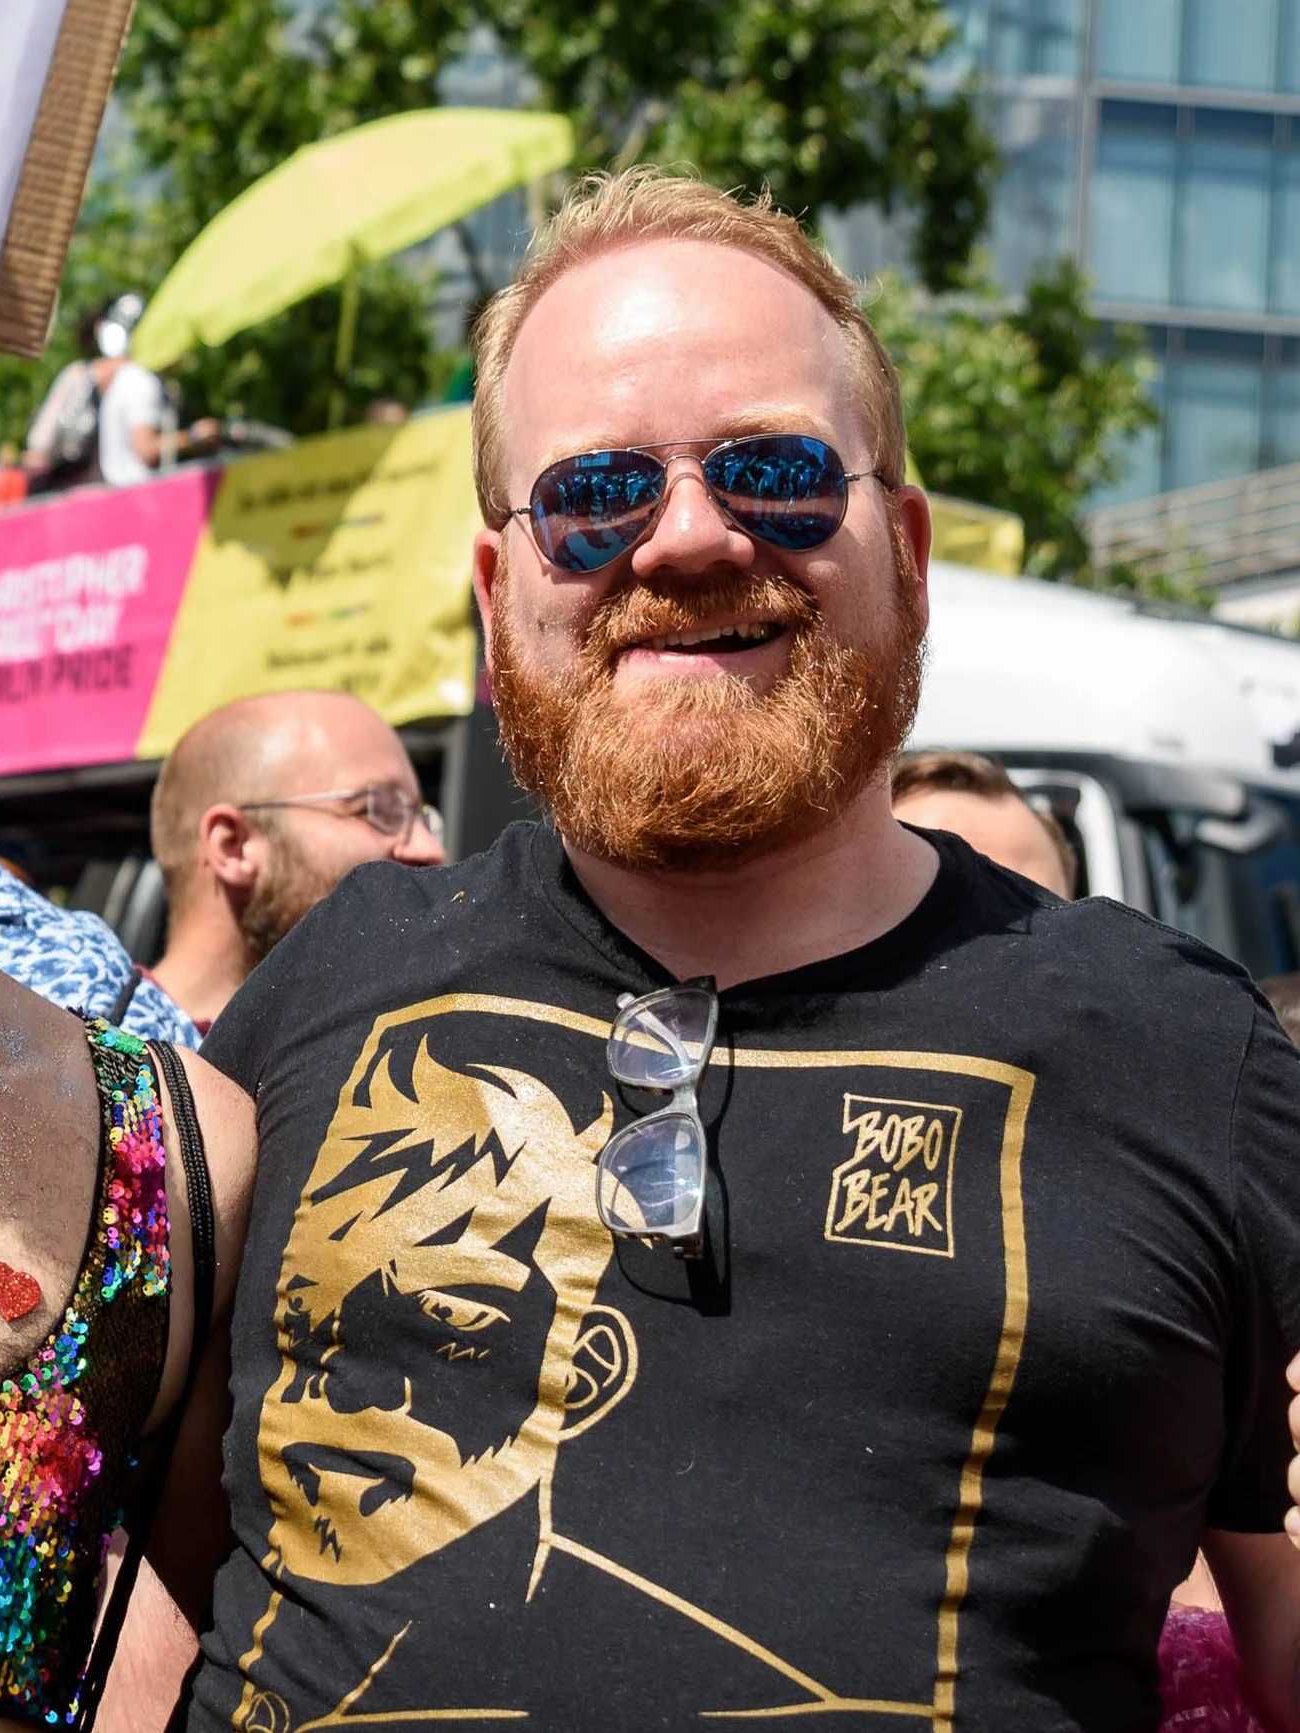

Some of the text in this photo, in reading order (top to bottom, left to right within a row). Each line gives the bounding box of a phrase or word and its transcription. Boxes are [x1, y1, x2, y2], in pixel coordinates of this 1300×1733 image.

[53, 600, 122, 653] DAY
[51, 643, 138, 691] PRIDE
[852, 1110, 943, 1172] BOBO
[834, 1168, 943, 1237] BEAR
